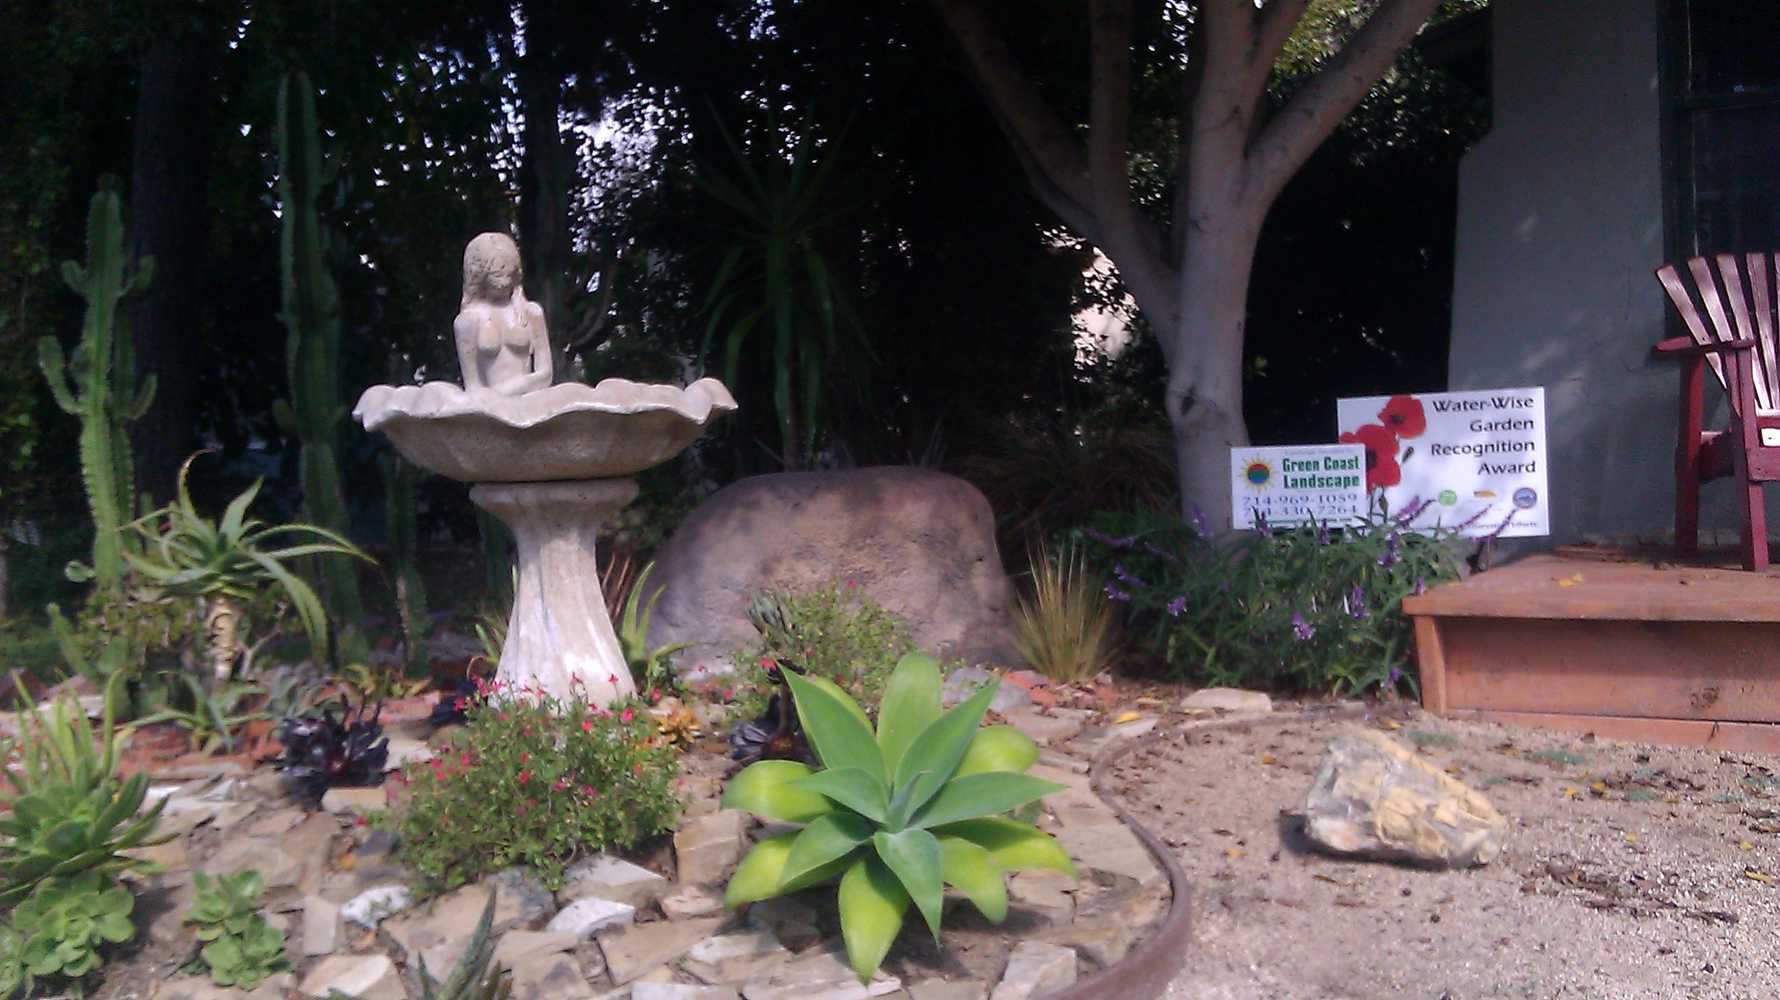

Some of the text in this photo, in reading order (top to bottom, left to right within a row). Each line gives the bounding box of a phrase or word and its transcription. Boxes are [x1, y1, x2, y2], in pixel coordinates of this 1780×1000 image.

[1432, 396, 1534, 413] Water-Wise
[1470, 418, 1534, 432] Garden
[1431, 440, 1535, 457] Recognition
[1282, 456, 1360, 472] Green Coast
[1478, 461, 1536, 475] Award
[1283, 474, 1360, 489] Landscape
